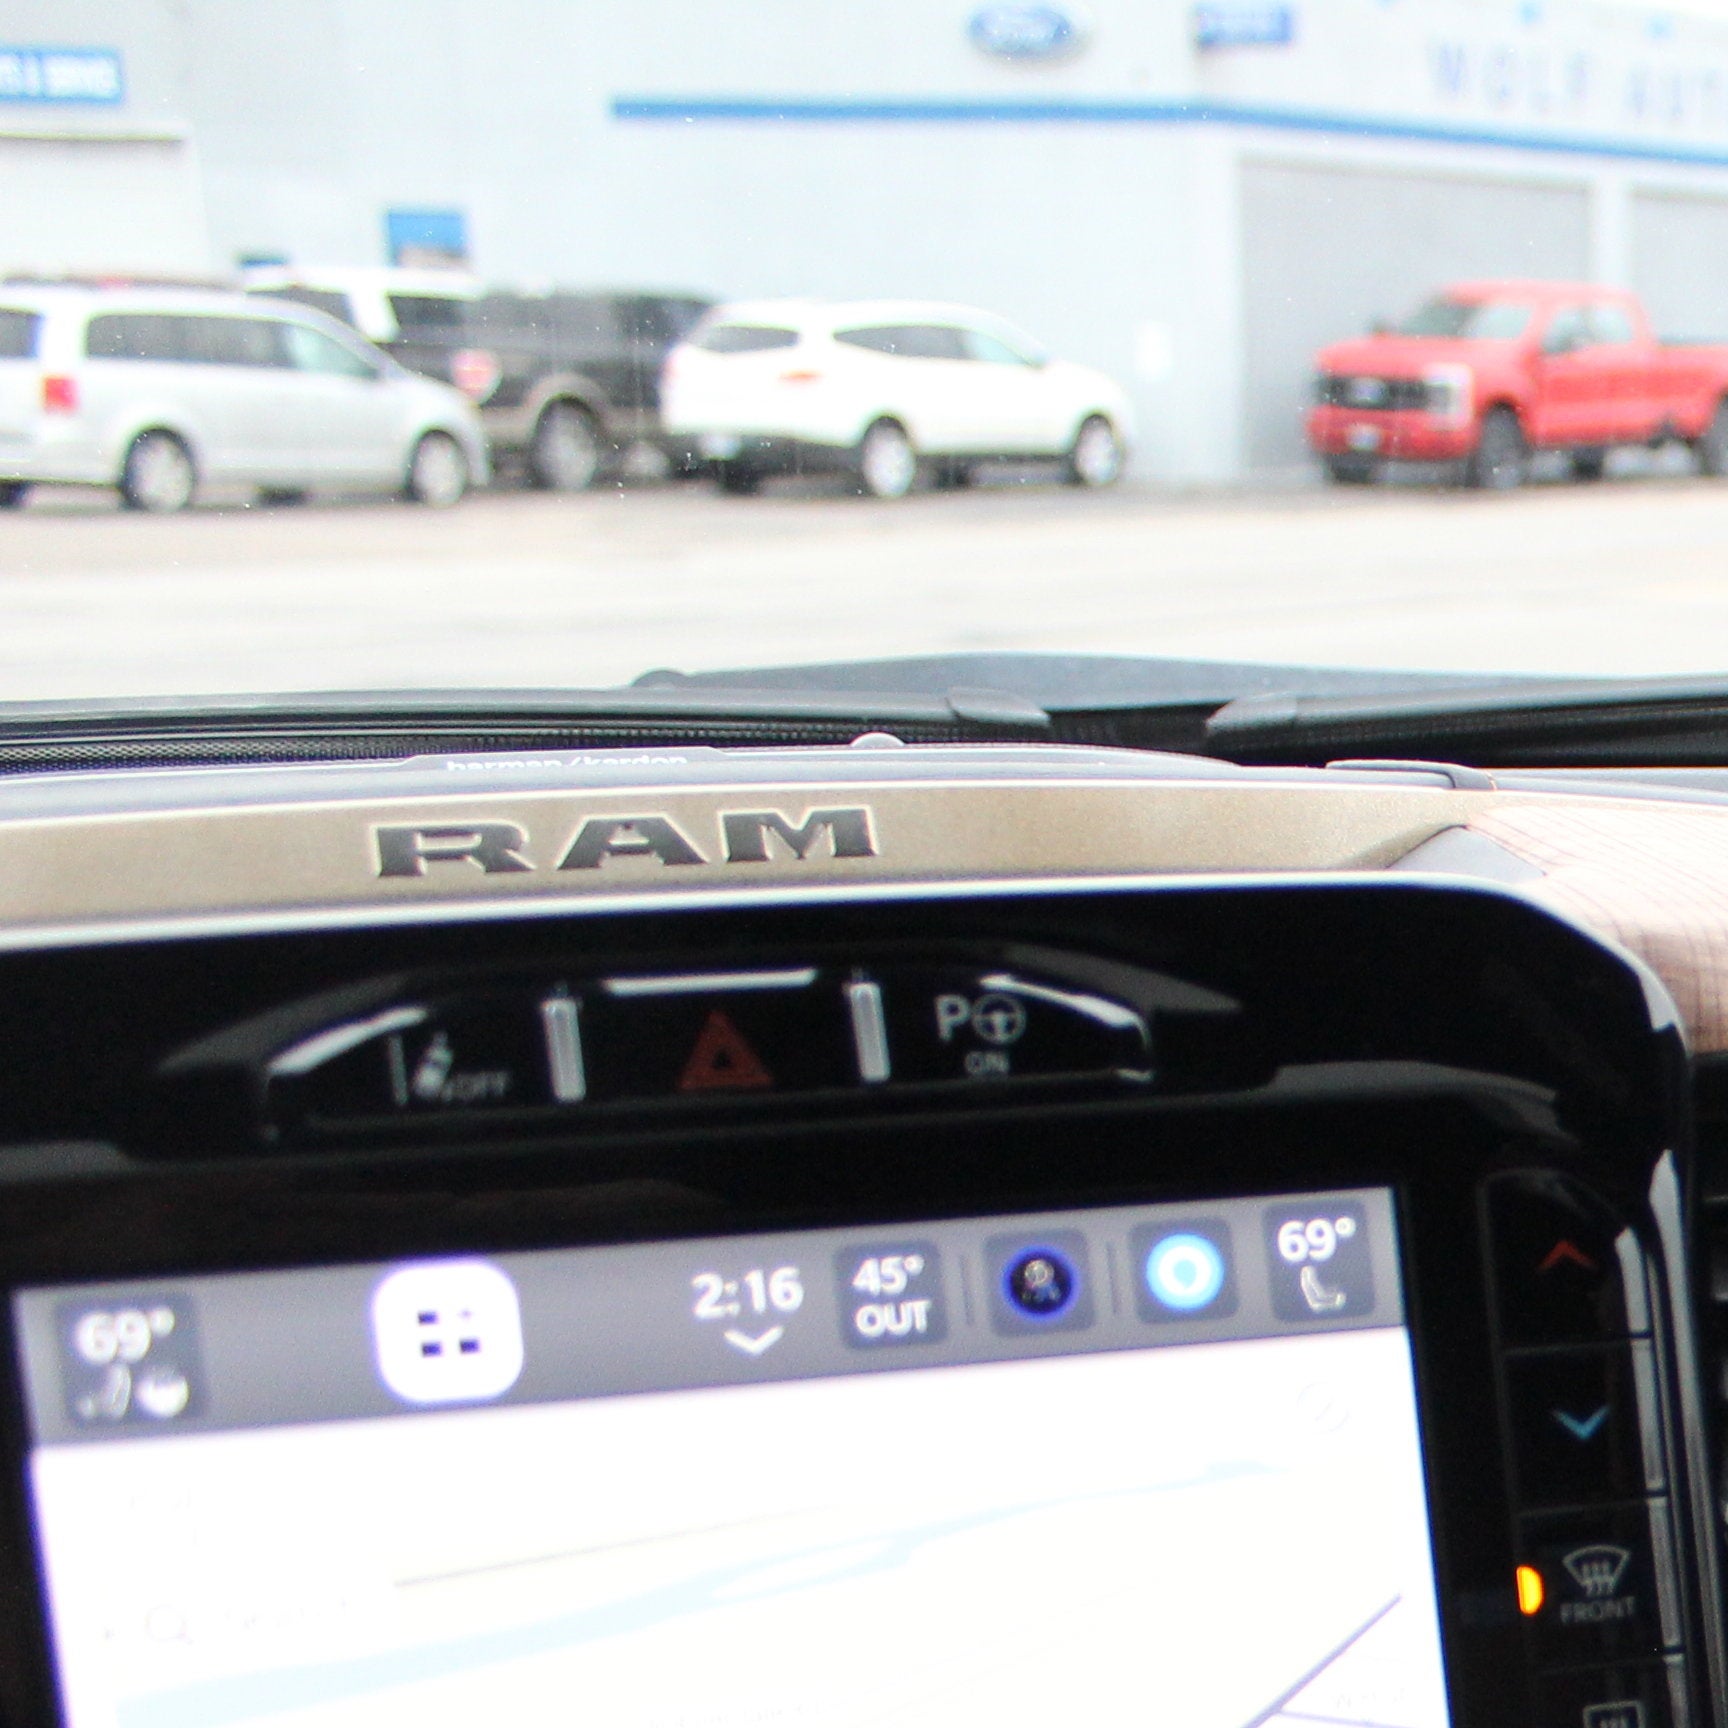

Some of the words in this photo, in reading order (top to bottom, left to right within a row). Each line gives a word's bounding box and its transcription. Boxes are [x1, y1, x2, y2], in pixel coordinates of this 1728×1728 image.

[372, 807, 880, 877] RAM
[692, 1268, 804, 1319] 2:16
[856, 1299, 932, 1338] OUT
[1560, 1596, 1636, 1624] FRONT
